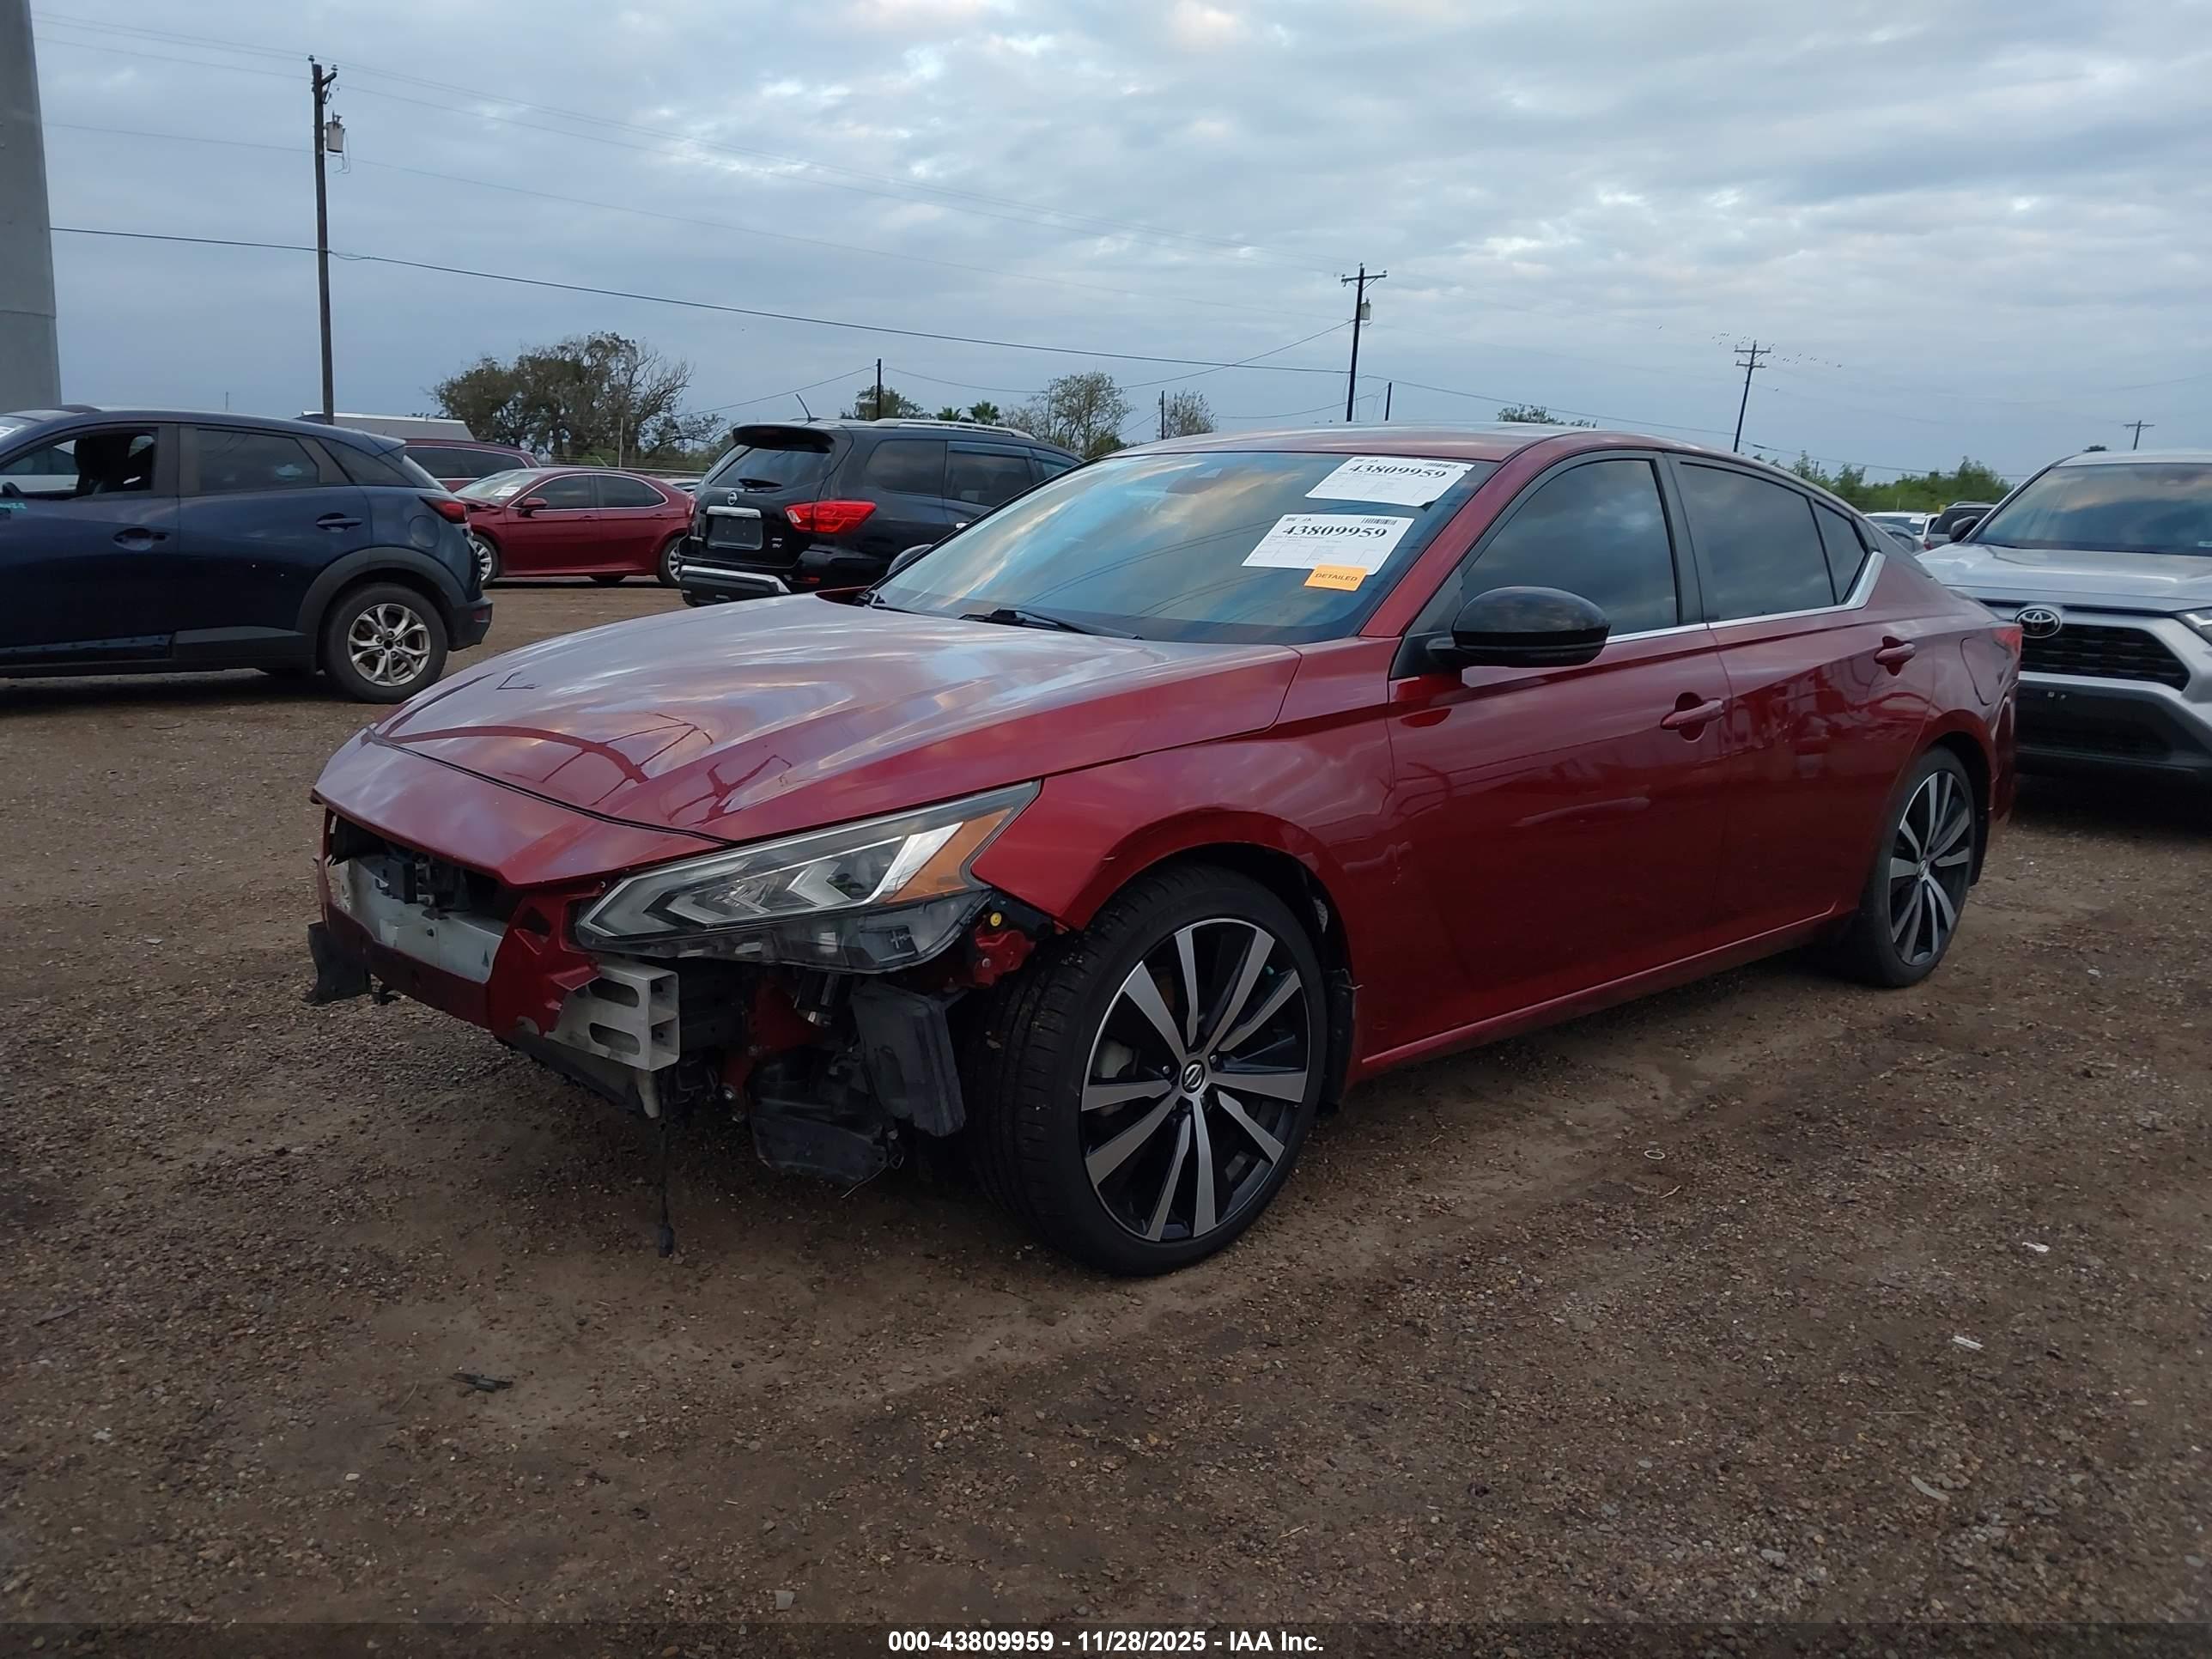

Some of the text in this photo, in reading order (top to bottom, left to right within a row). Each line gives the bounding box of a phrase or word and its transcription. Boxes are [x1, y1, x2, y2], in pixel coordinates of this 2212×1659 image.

[1349, 465, 1447, 478] 43809959
[1283, 526, 1388, 538] 43809959
[1315, 572, 1358, 582] DETAILED
